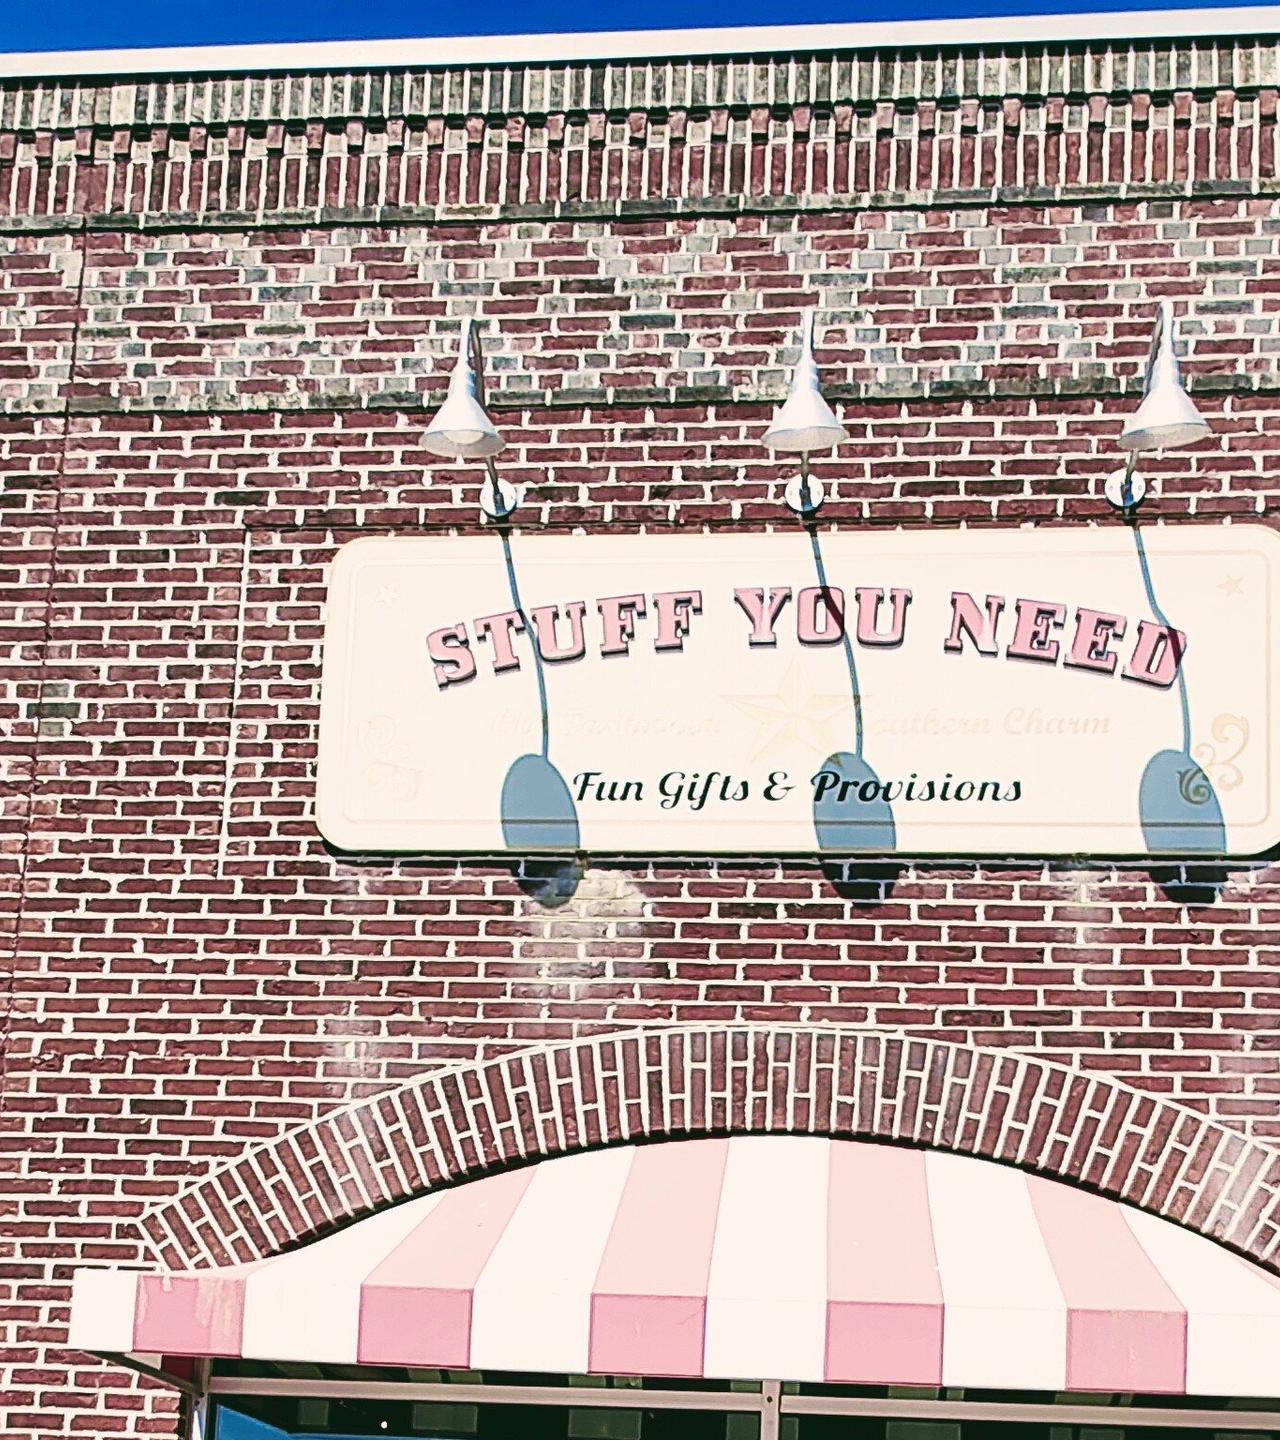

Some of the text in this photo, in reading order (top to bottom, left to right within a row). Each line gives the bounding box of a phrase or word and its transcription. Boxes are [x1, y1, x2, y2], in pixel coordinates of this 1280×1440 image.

[426, 585, 1188, 692] STUFF YOU NEED
[573, 770, 1023, 811] Fun Gifts & Provisions
